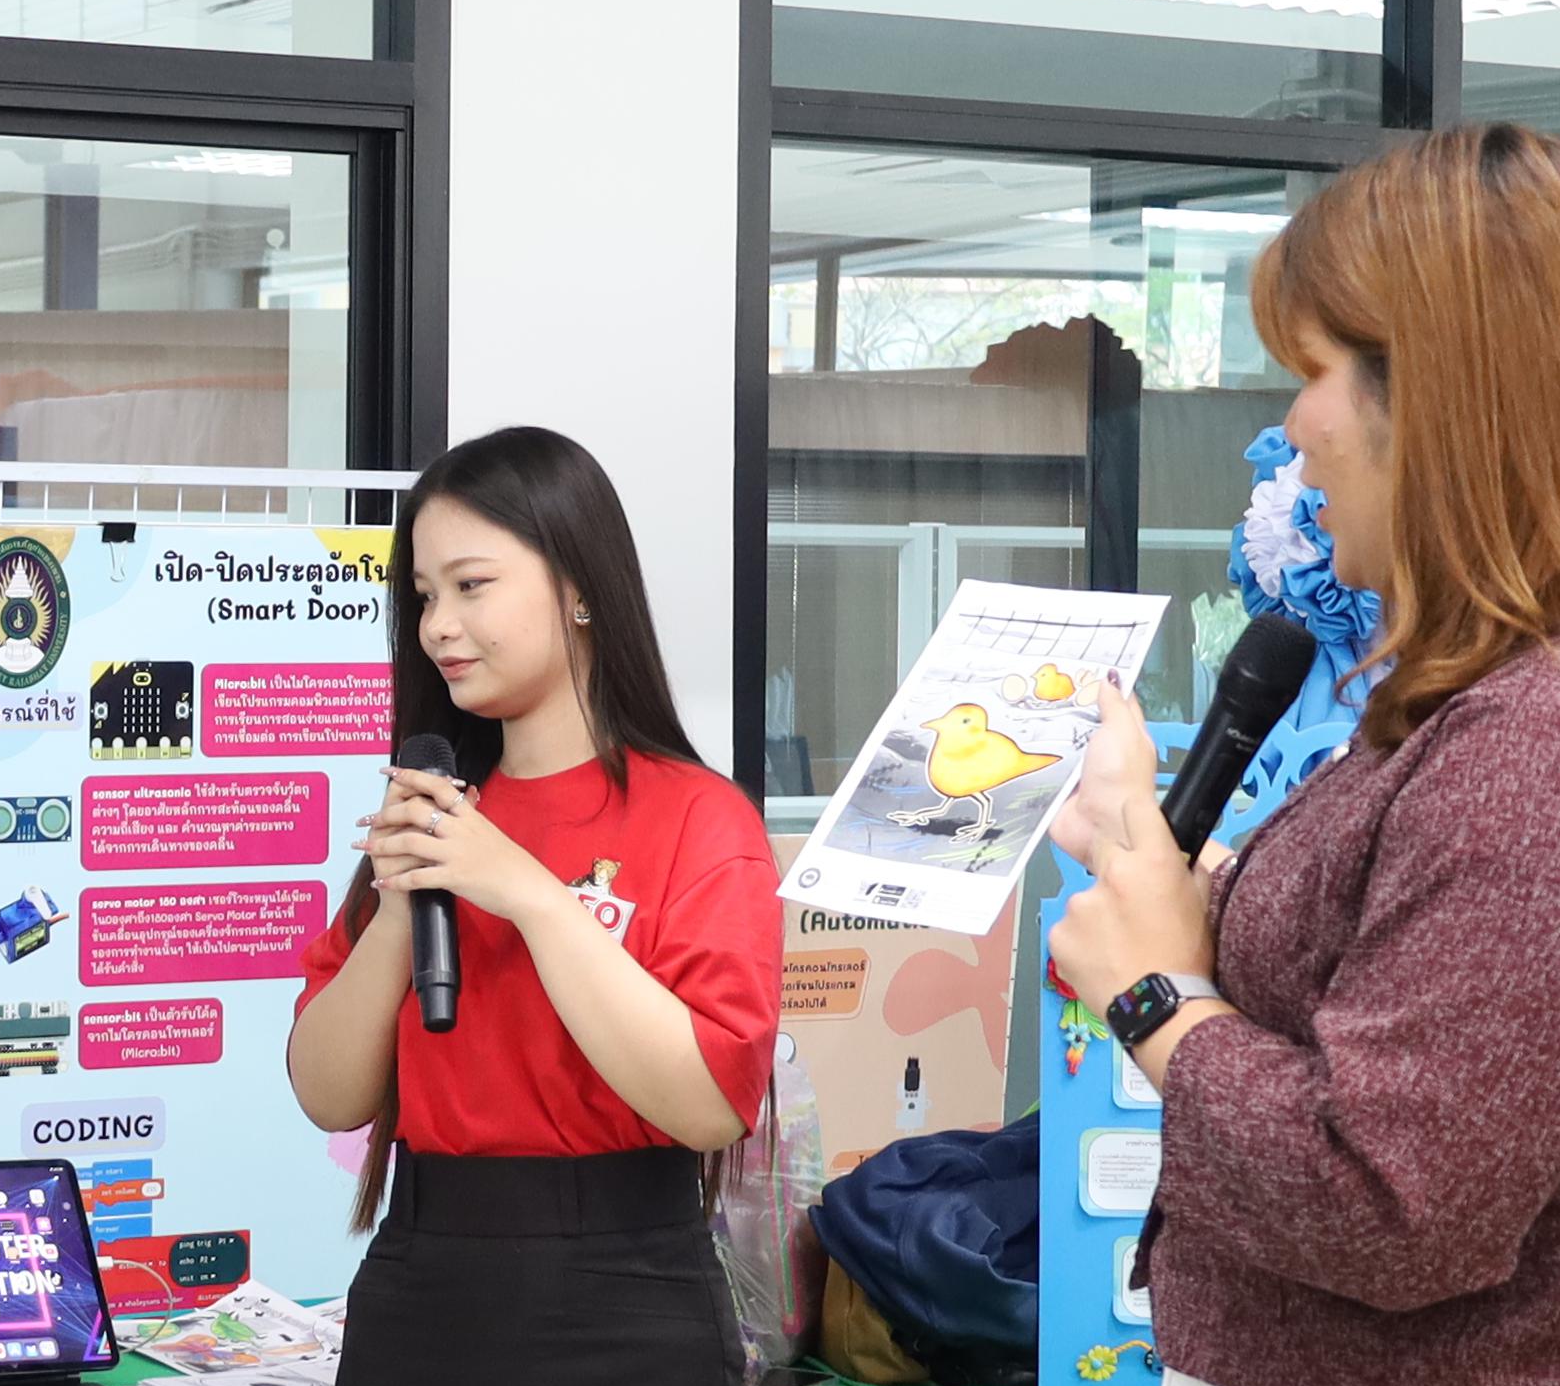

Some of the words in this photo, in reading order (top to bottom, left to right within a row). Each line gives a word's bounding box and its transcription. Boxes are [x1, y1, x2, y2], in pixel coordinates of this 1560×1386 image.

[207, 597, 296, 623] (Smart
[307, 597, 380, 623] Door)
[214, 678, 266, 689] Micro:bit
[92, 790, 130, 800] sensor
[134, 787, 192, 799] ultrasonic
[92, 900, 121, 909] servo
[124, 897, 156, 908] motor
[195, 911, 225, 922] Servo
[83, 1009, 142, 1025] sensor:bit
[87, 1022, 215, 1042] จากไมโครคอนโทรเลอร์
[121, 1044, 181, 1060] (Micro:bit)
[33, 1114, 154, 1145] CODING
